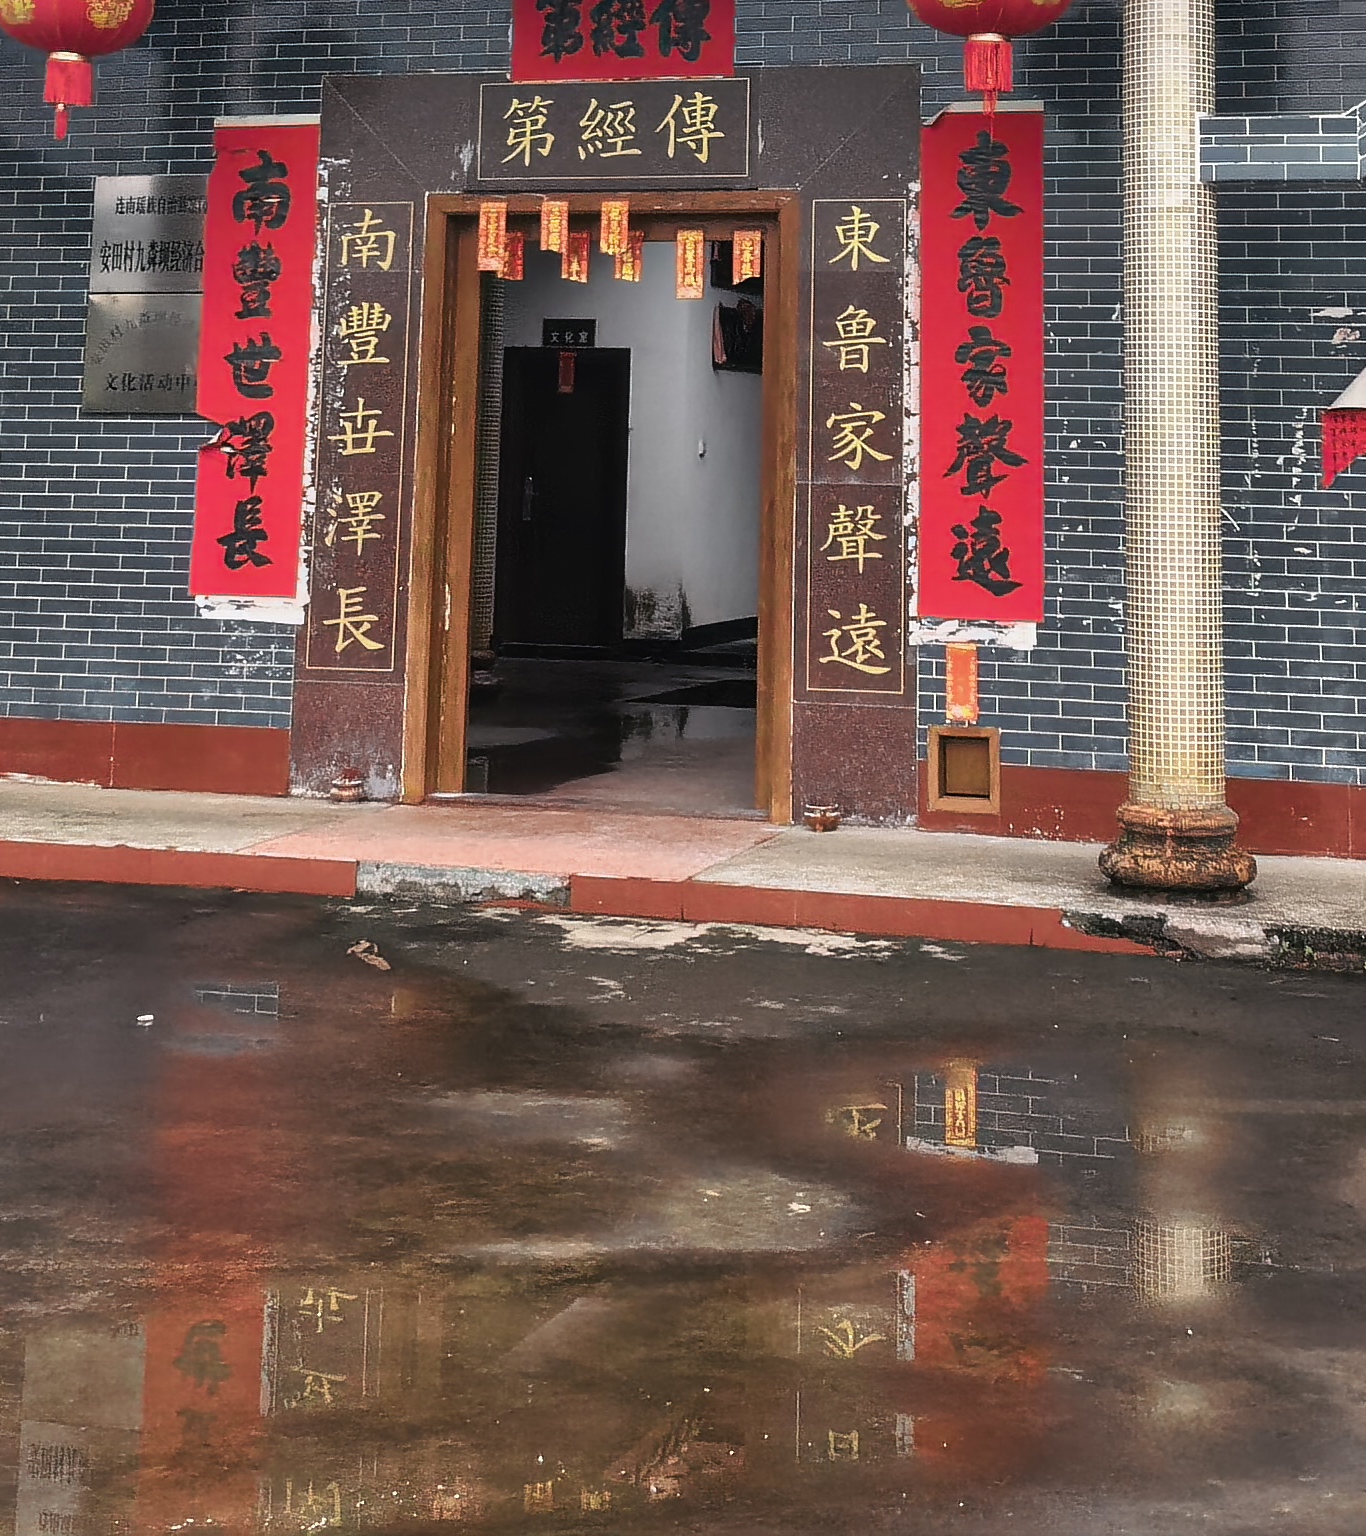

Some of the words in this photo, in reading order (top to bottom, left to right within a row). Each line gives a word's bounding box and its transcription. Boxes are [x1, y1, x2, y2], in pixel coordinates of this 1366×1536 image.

[550, 330, 589, 343] 文化室
[105, 373, 197, 392] 文化活动中
